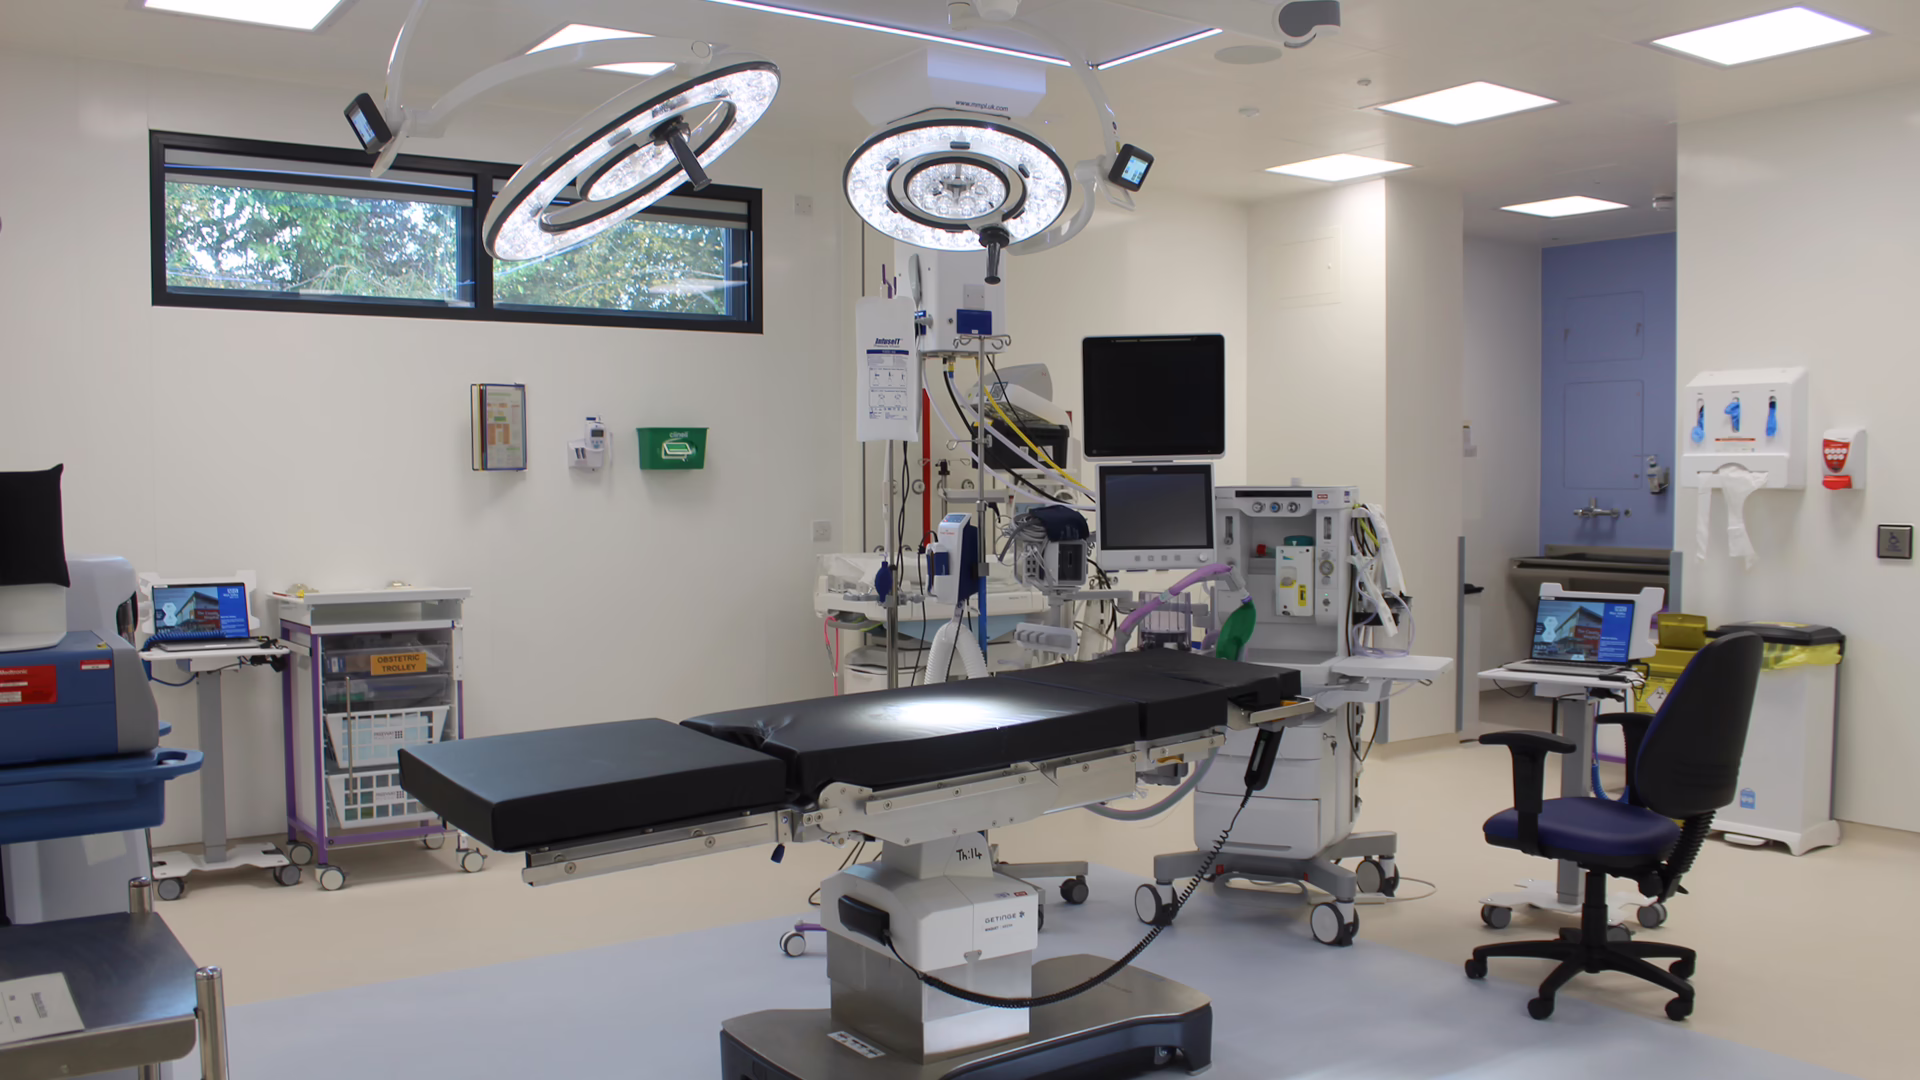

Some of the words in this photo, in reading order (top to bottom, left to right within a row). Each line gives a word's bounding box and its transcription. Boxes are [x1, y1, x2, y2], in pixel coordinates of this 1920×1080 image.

[377, 654, 420, 663] OBSTETRIC
[382, 664, 416, 672] TROLLEY
[984, 913, 1017, 924] GETINGE
